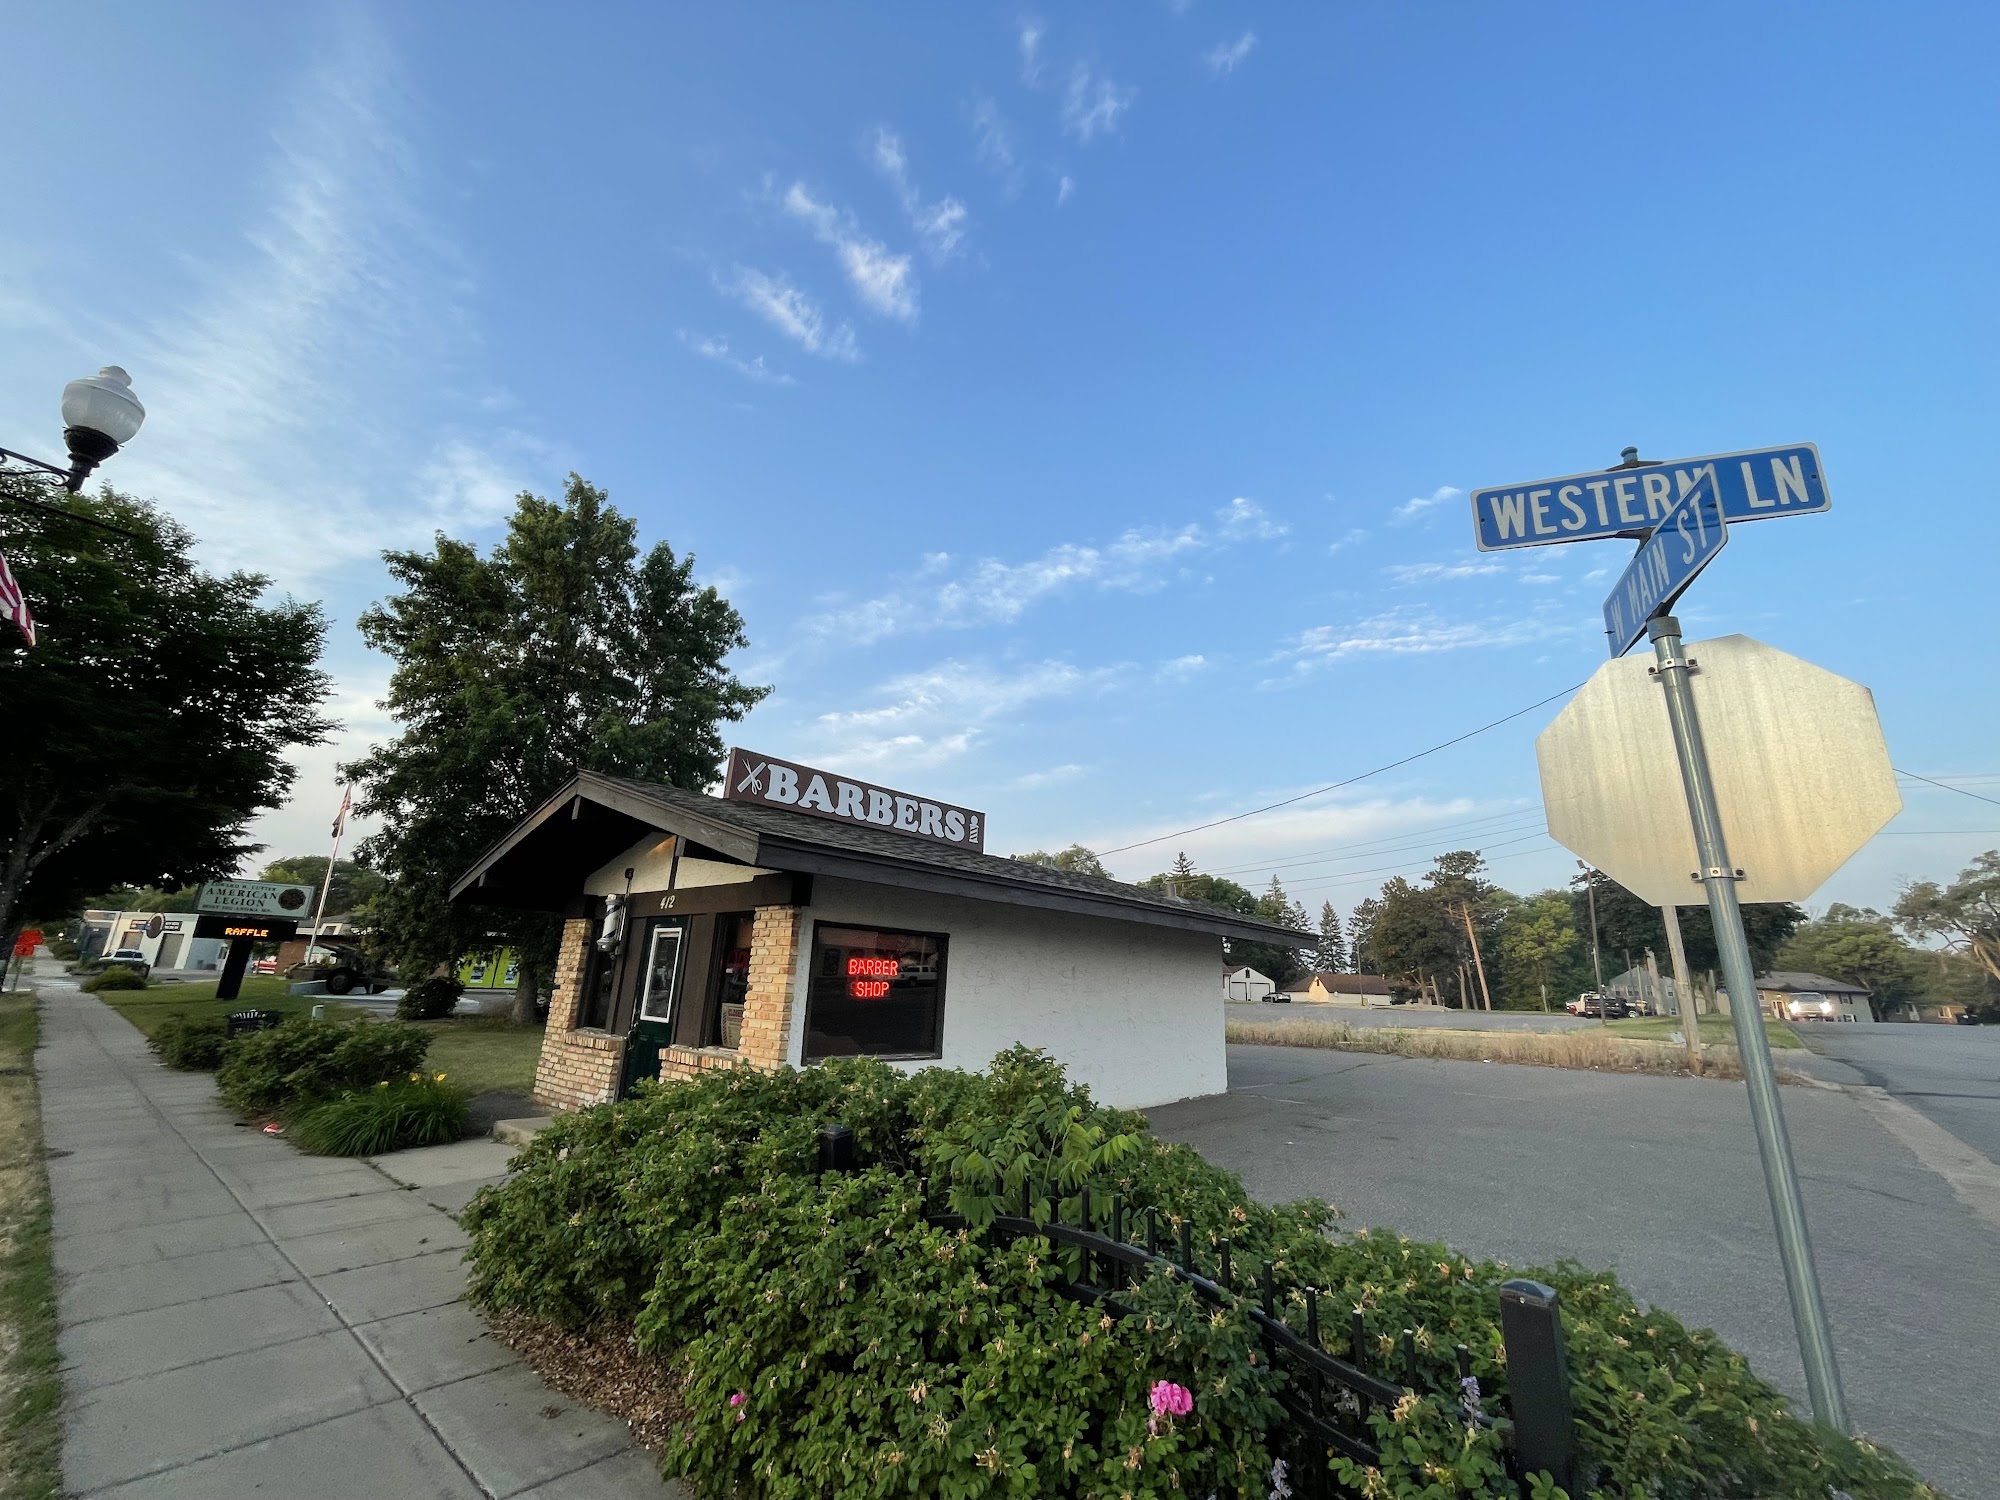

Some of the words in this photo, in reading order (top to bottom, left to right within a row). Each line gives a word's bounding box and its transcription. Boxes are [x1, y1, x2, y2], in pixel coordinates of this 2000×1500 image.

[1741, 455, 1809, 508] LN
[1610, 595, 1625, 645] W
[1626, 537, 1670, 624] MAIN
[1677, 491, 1707, 565] ST
[764, 763, 966, 842] BARBERS
[206, 888, 278, 900] AMERICAN
[214, 896, 266, 907] LEGION
[660, 895, 676, 909] 412
[225, 927, 269, 937] RAFFLE
[848, 958, 899, 976] BARBER
[855, 981, 890, 997] SHOP
